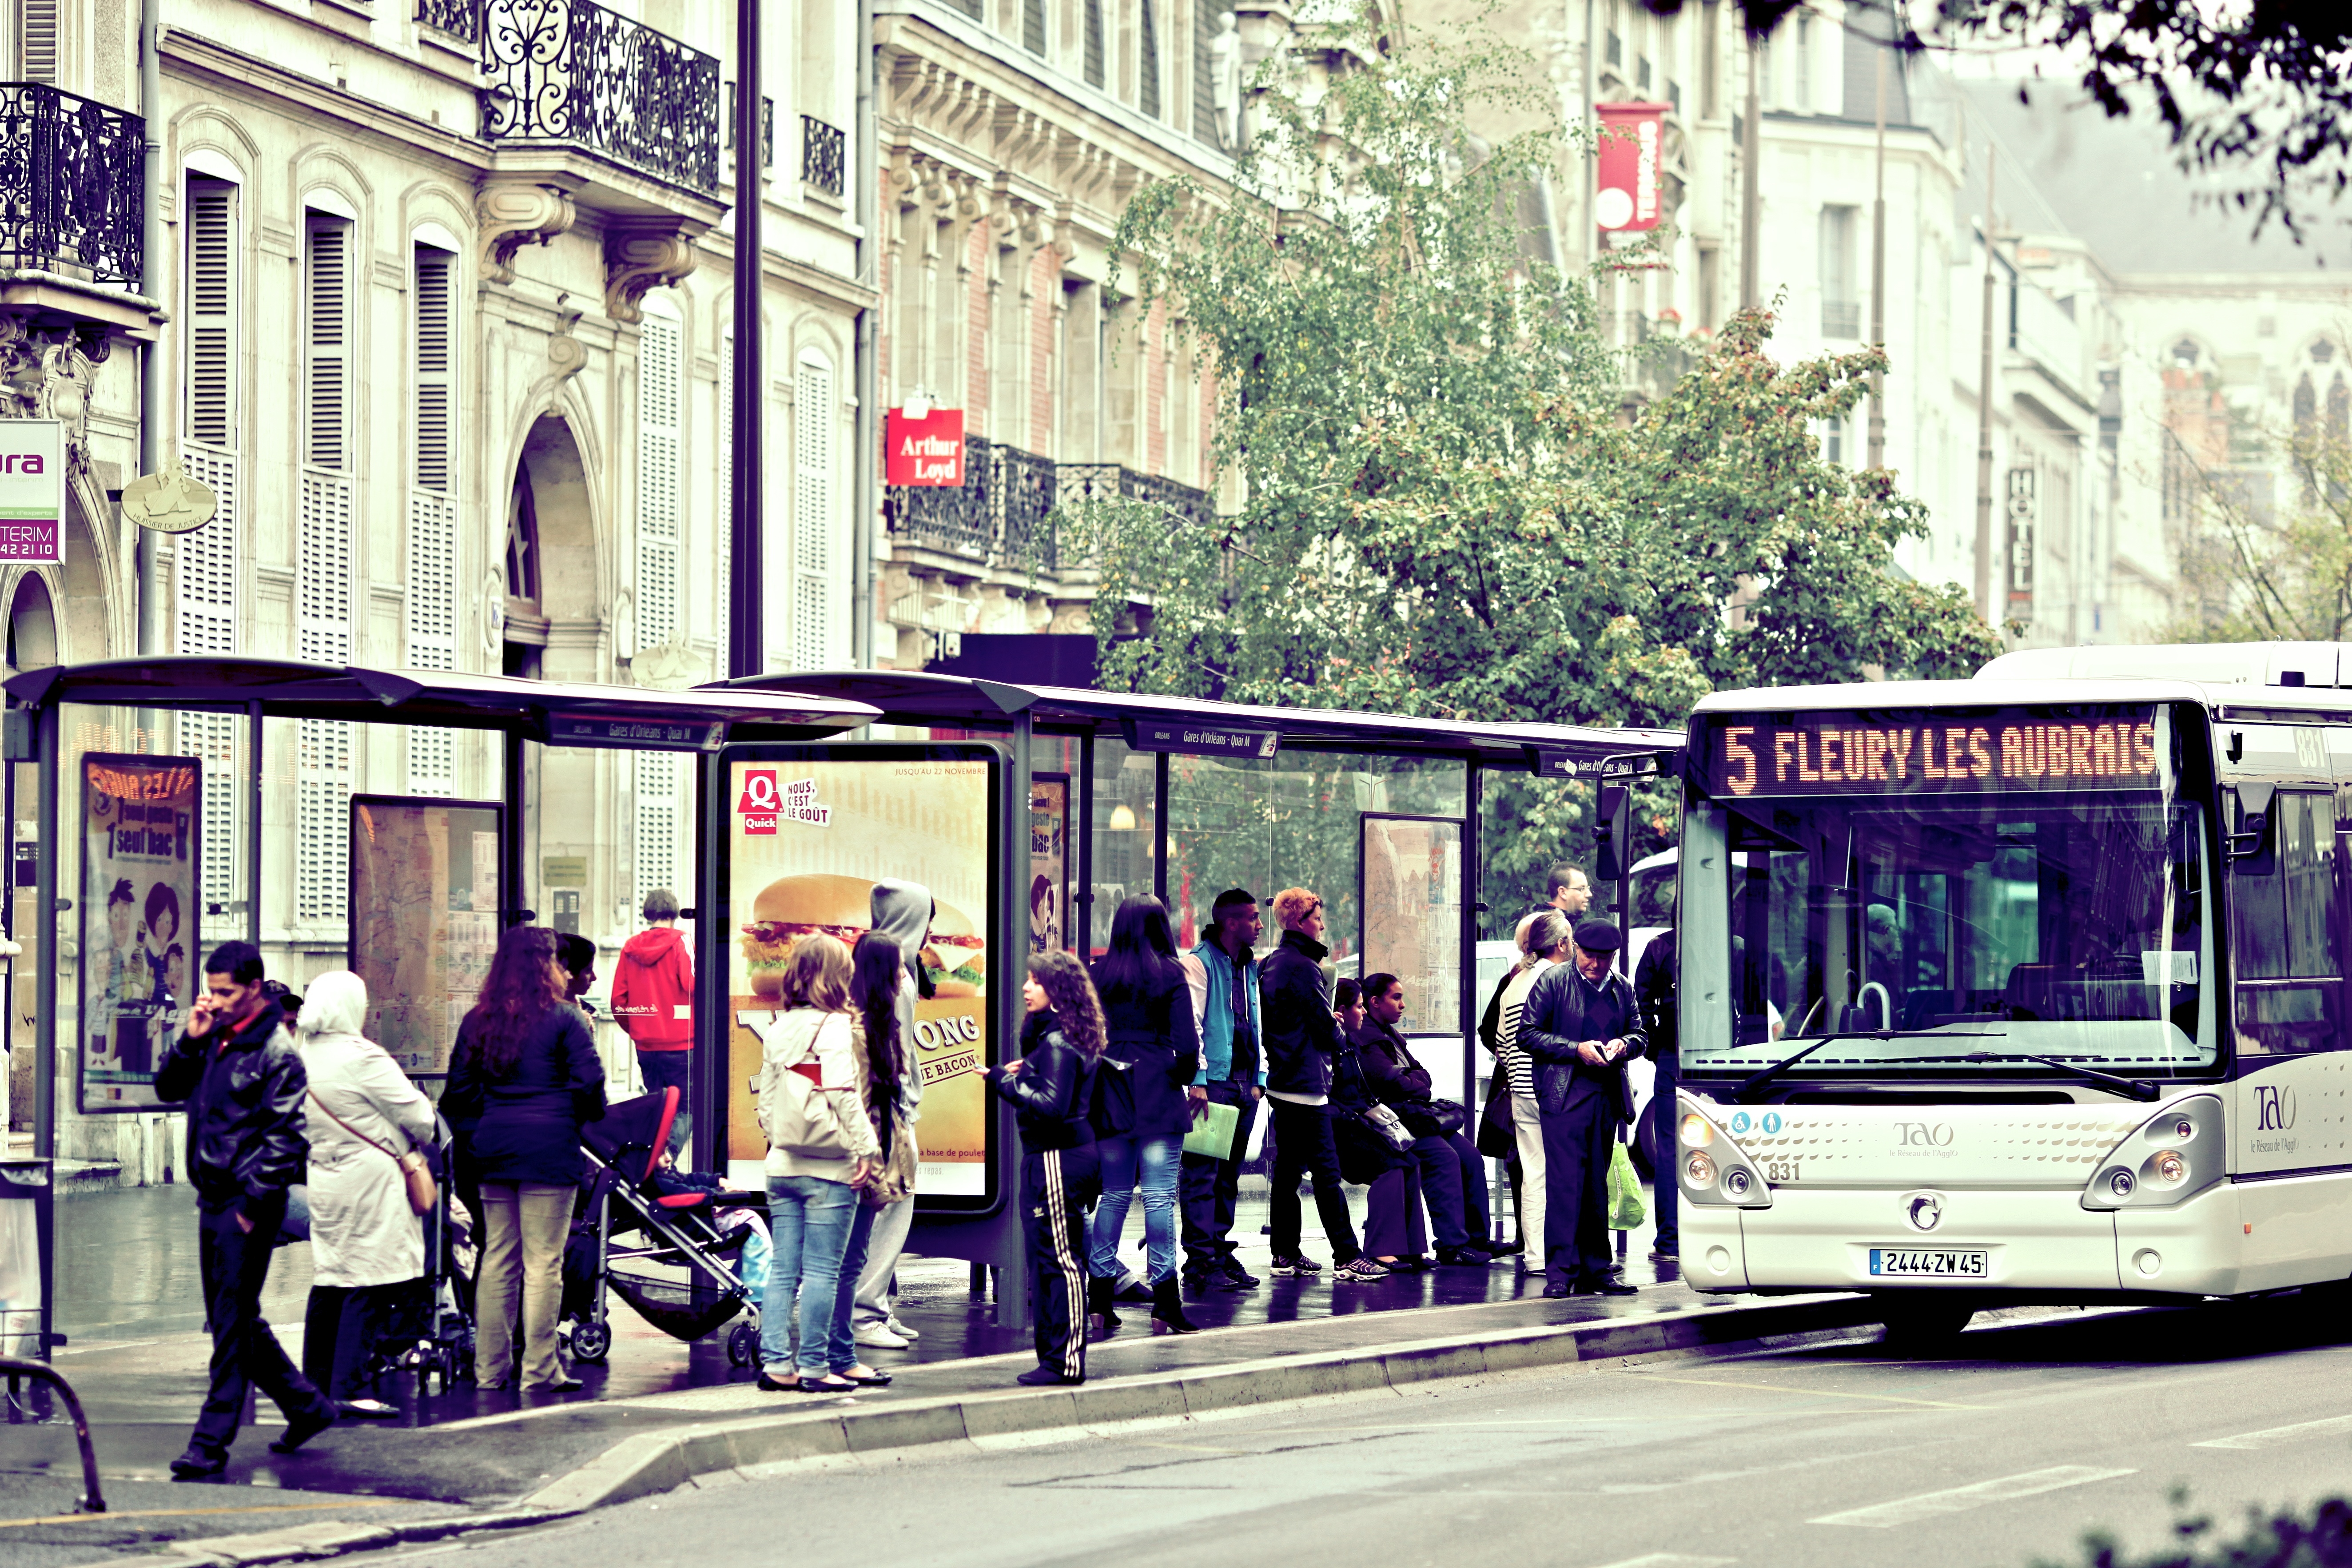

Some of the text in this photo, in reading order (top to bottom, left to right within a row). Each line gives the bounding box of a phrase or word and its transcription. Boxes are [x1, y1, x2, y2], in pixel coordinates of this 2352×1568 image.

[900, 434, 959, 456] Arthur
[0, 454, 44, 474] ra
[915, 458, 956, 485] Loyd
[133, 513, 162, 529] HUISSIER
[178, 515, 204, 529] JUSTICE
[2009, 470, 2034, 591] HOTEL
[0, 544, 52, 554] 42 21 10
[609, 723, 628, 737] Gares
[668, 726, 682, 741] Quai
[683, 728, 690, 740] M
[1183, 731, 1199, 743] Gares
[1200, 731, 1226, 745] d'Orléans
[1231, 735, 1244, 748] Quai
[1244, 736, 1250, 747] M
[2296, 729, 2325, 768] 831
[1579, 760, 1592, 771] Gares
[1618, 762, 1629, 773] Quai
[1726, 723, 2156, 795] 5 FLEURY LES AUBRAIS
[748, 776, 776, 809] Q
[788, 781, 815, 794] NOUS,
[788, 796, 809, 806] C'EST
[746, 818, 776, 829] Quick
[788, 807, 828, 823] LE GOÛT
[1032, 812, 1050, 828] geste
[107, 822, 172, 859] 1 seul bac
[1032, 830, 1049, 853] bac
[914, 1015, 980, 1051] ONG
[959, 1149, 985, 1158] poulet
[2251, 1140, 2255, 1153] le
[2256, 1139, 2273, 1153] Réseau
[2274, 1138, 2280, 1151] de
[924, 1167, 944, 1176] repas.
[1768, 1162, 1800, 1180] 831
[1887, 1253, 1931, 1272] 2444
[1935, 1254, 1955, 1273] ZW
[1960, 1254, 1981, 1274] 45
